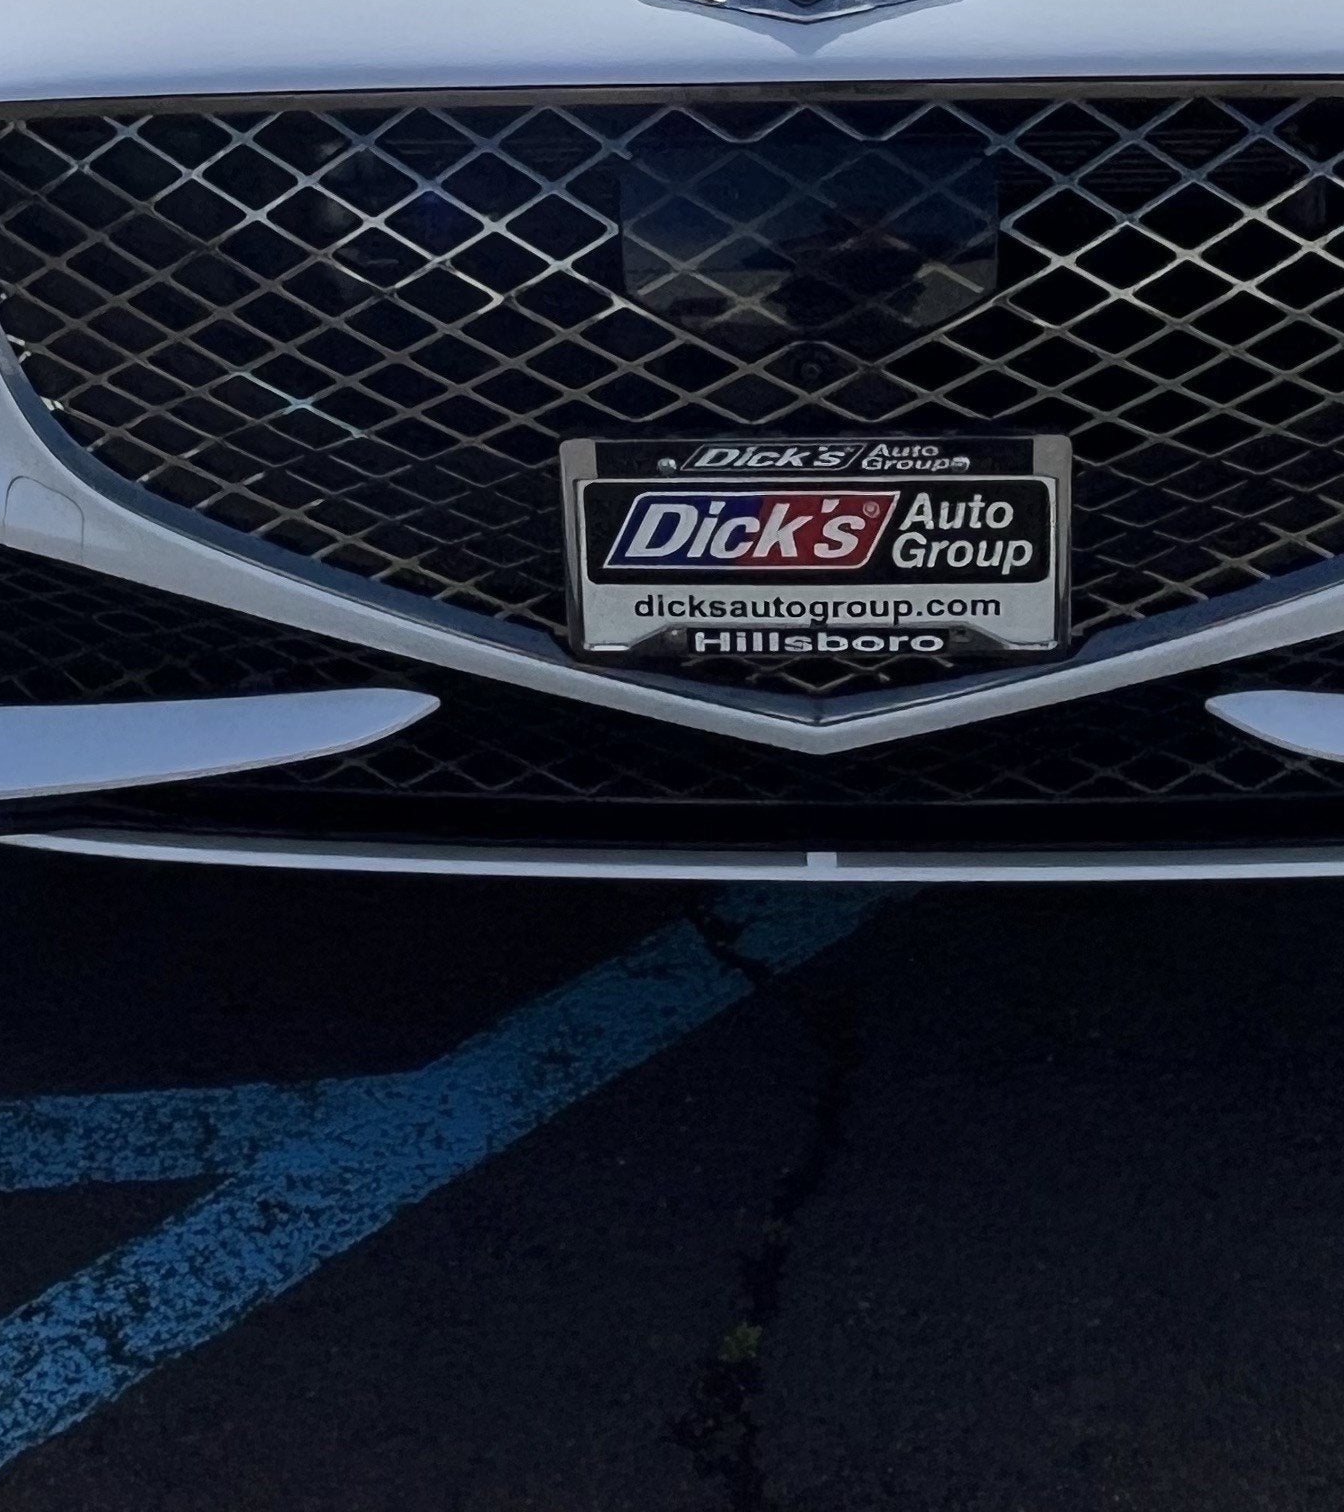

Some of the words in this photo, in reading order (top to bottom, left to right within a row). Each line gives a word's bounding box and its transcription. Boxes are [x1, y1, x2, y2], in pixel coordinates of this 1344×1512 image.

[694, 445, 845, 467] Dick's
[868, 443, 940, 457] Auto
[861, 456, 955, 472] Group
[899, 492, 1014, 531] Auto
[625, 499, 866, 559] Dick's
[892, 532, 1033, 575] Group
[634, 595, 1002, 626] dicksautogroup.com
[693, 631, 945, 653] Hillsboro
